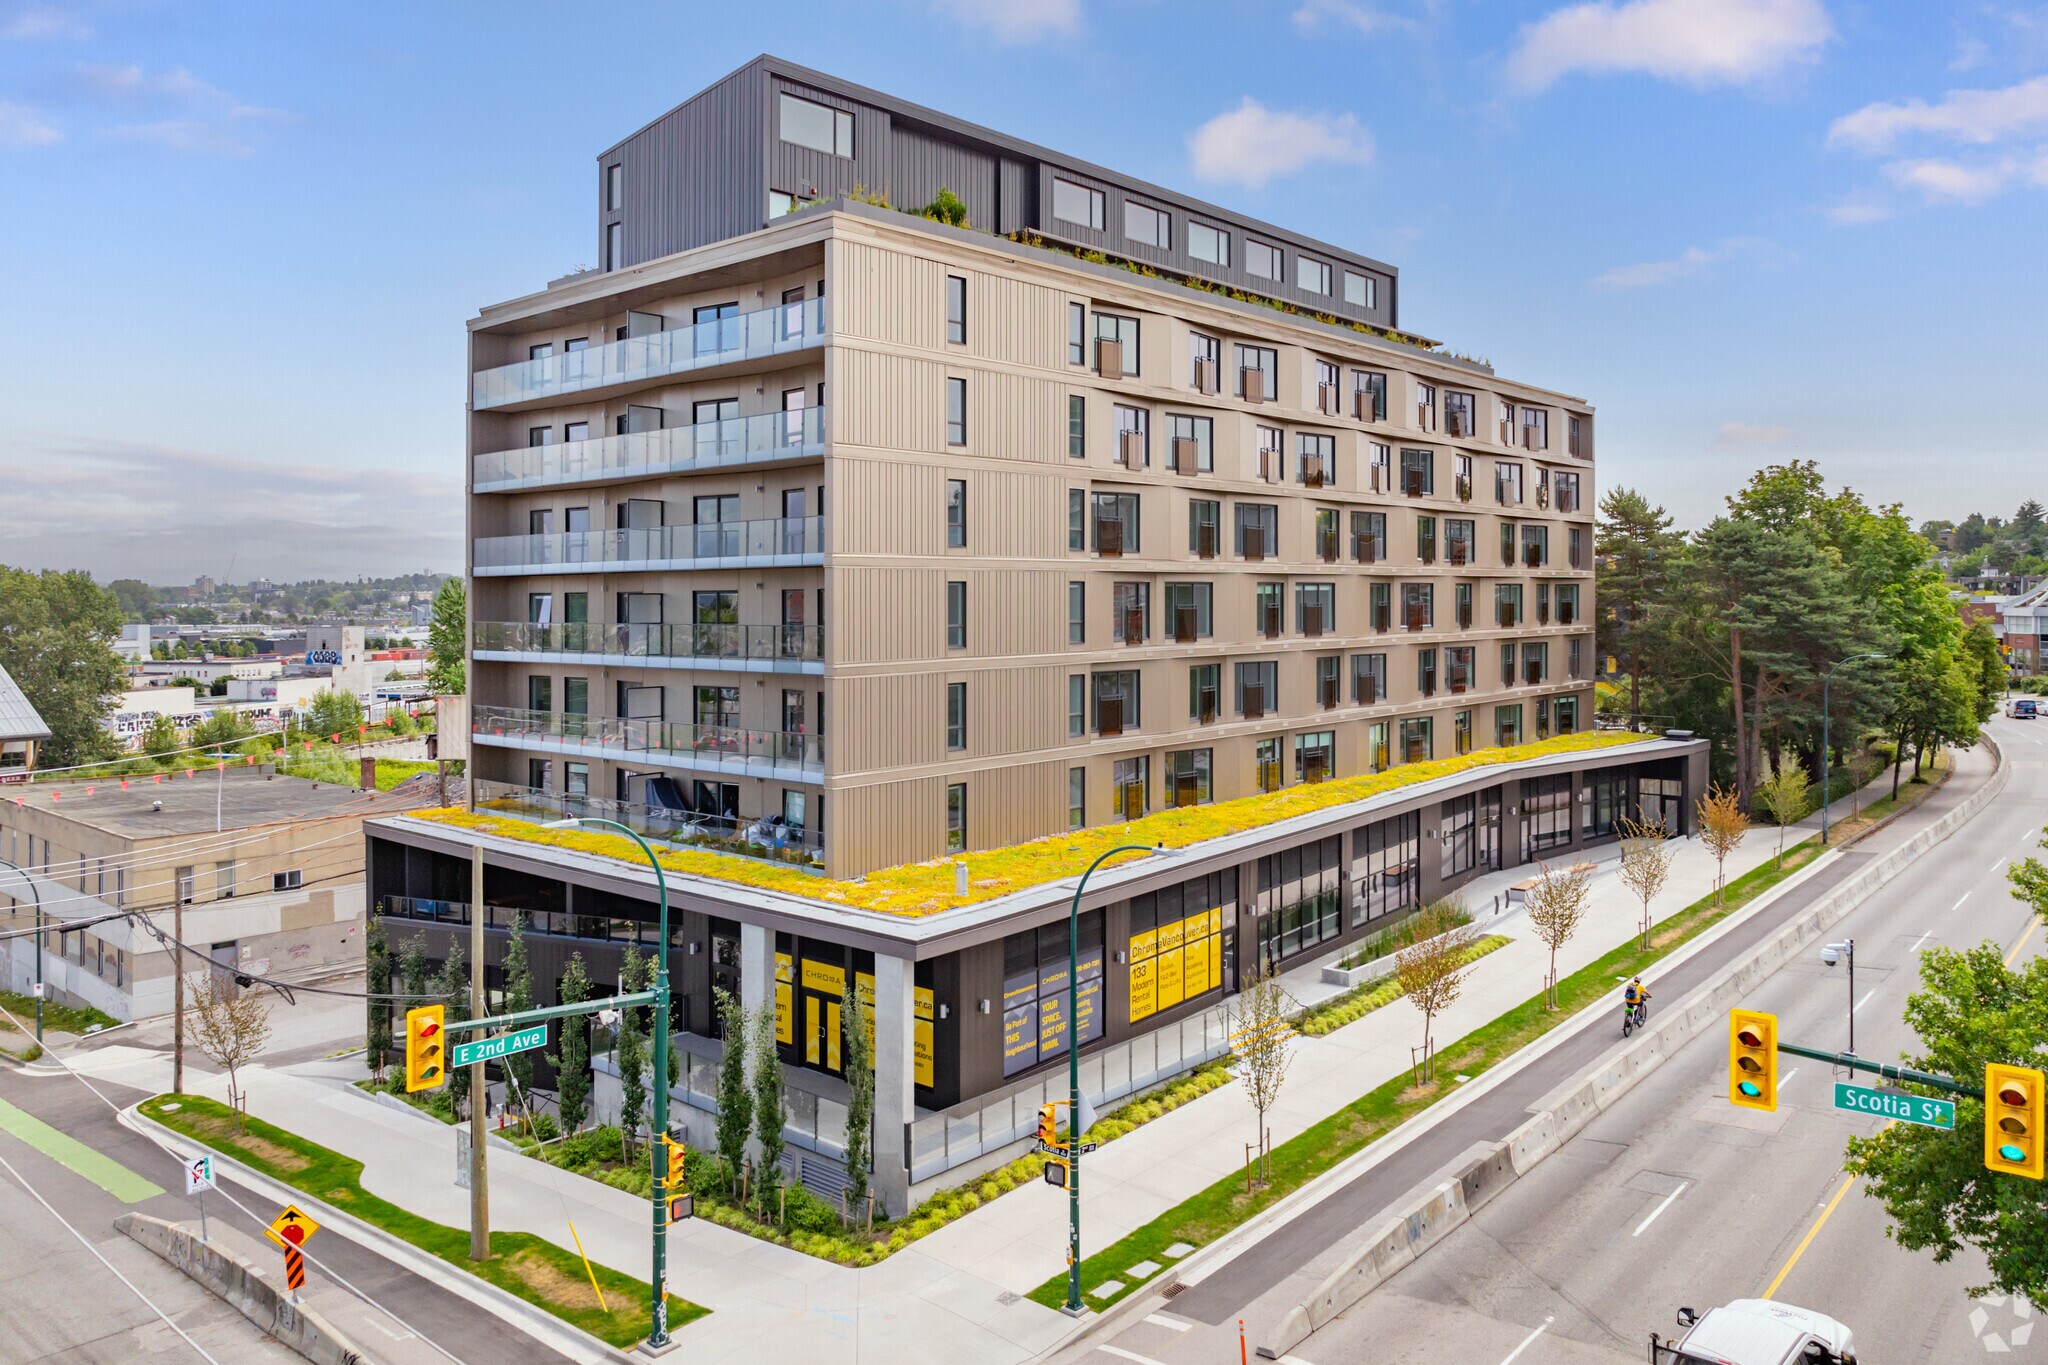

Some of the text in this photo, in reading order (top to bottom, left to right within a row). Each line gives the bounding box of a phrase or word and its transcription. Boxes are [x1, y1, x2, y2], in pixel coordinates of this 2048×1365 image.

[1131, 924, 1209, 958] ChromaVancouver.ca
[1131, 965, 1147, 980] 133
[1131, 978, 1155, 992] Modern
[1131, 990, 1151, 1005] Rental
[1041, 999, 1058, 1012] YOUR
[1131, 1003, 1152, 1016] Homes
[1041, 1026, 1055, 1039] JUST
[1055, 1021, 1067, 1033] OFF
[1005, 1032, 1020, 1045] THIS
[461, 1033, 540, 1062] E 2nd Ave
[1845, 1089, 1942, 1120] Scotia St
